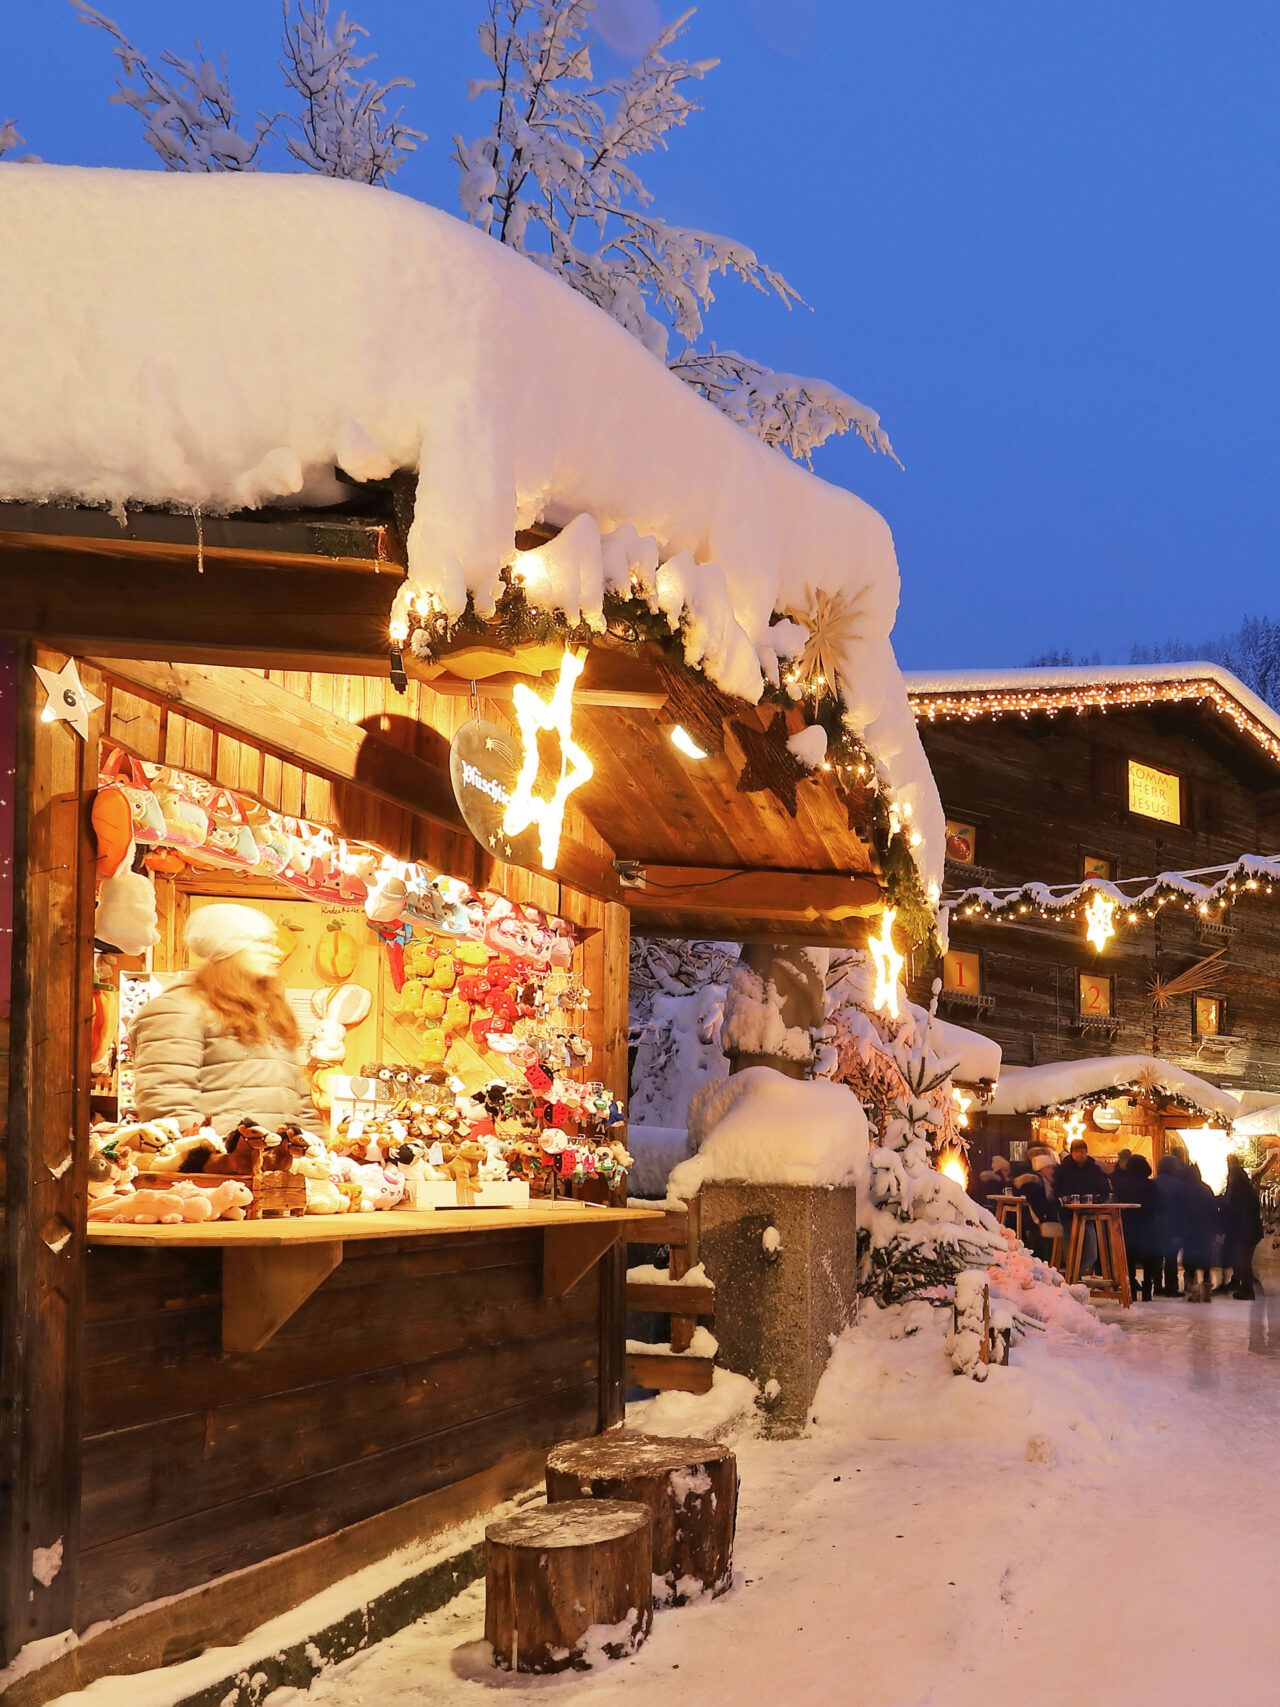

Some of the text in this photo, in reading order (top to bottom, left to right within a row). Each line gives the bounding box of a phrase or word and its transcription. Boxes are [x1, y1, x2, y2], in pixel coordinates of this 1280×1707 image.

[63, 688, 77, 707] 6
[1132, 779, 1166, 801] HERR
[1132, 794, 1170, 817] JESUS!
[954, 963, 966, 988] 1
[1088, 986, 1101, 1010] 2
[1200, 1008, 1212, 1031] 3
